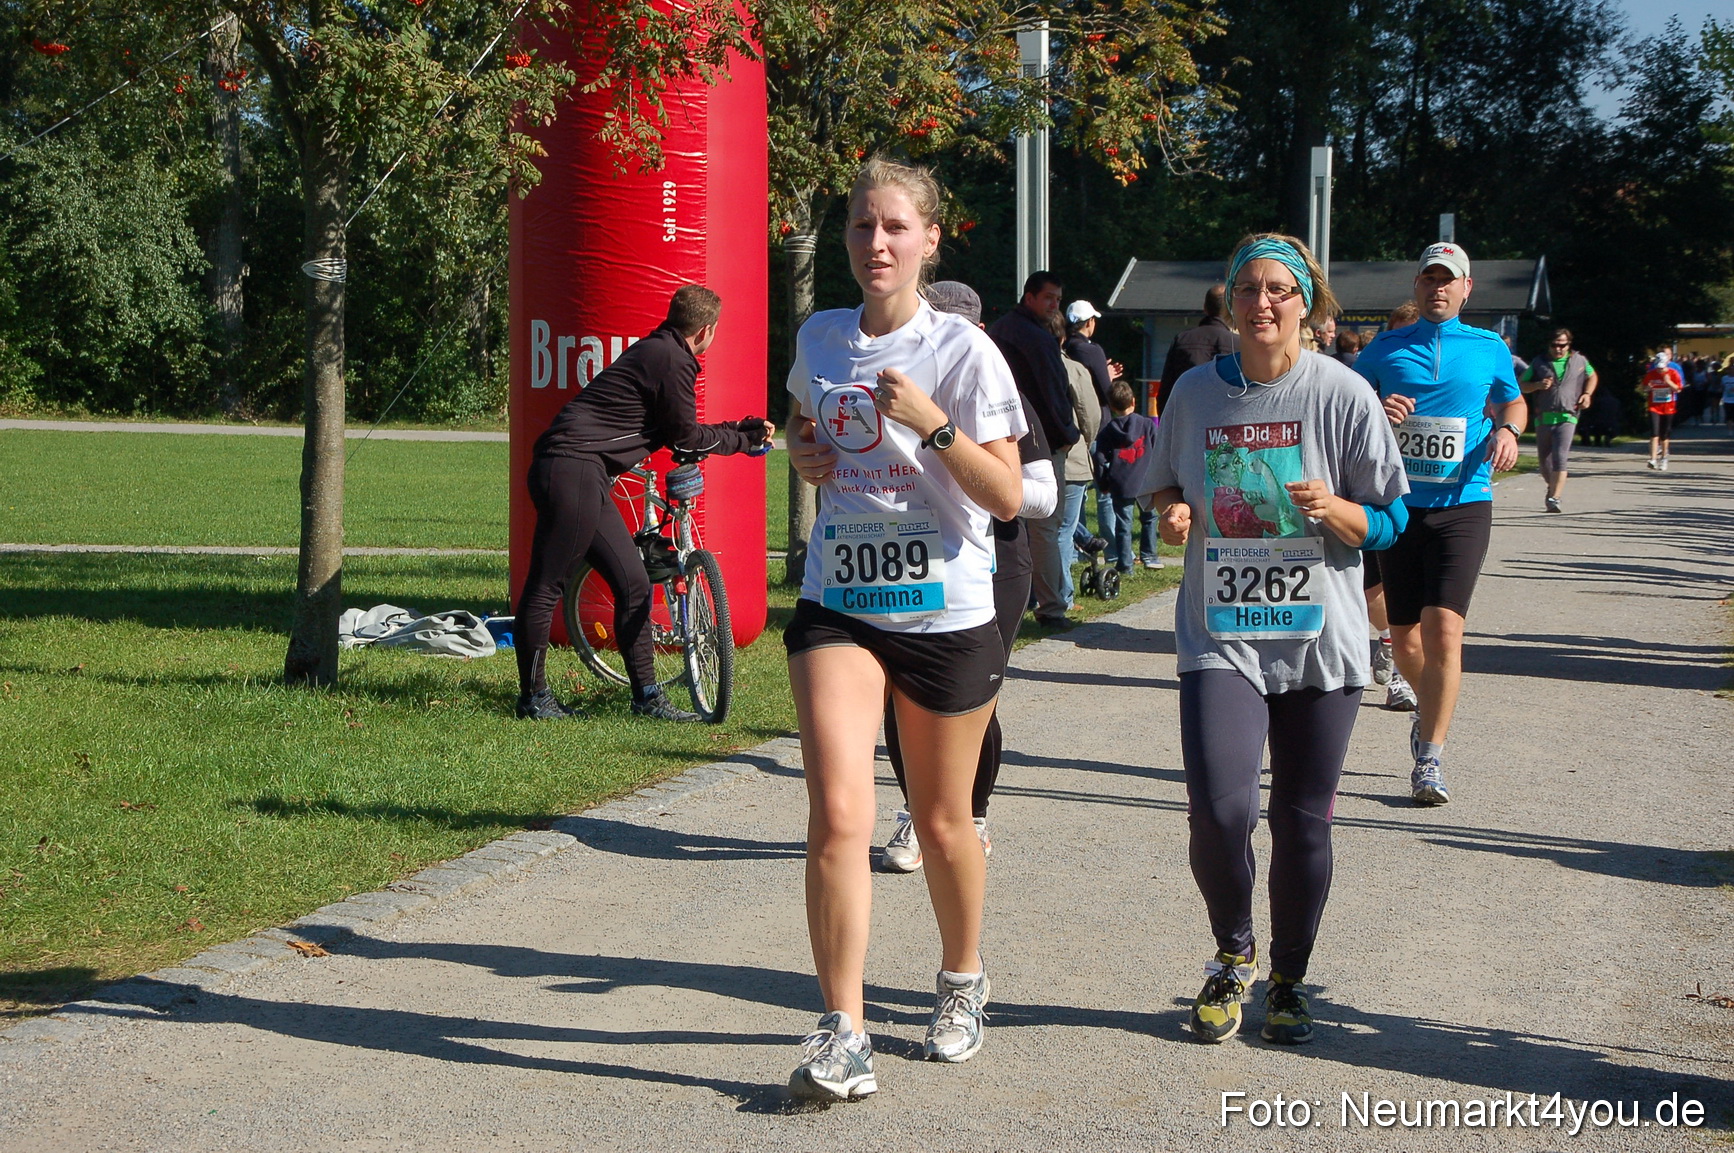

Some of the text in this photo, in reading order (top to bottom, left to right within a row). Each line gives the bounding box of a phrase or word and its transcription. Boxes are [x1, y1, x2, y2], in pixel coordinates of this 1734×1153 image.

[663, 181, 676, 242] Seit 1929
[531, 319, 640, 389] Bra
[1208, 423, 1298, 445] We Did It!
[1400, 431, 1456, 460] 2366
[1405, 458, 1446, 476] Holger
[836, 522, 885, 534] PFLEIDERER
[834, 540, 929, 584] 3089
[1220, 548, 1270, 558] PFLEIDERER
[1216, 565, 1311, 604] 3262
[842, 587, 924, 609] Corinna
[1235, 606, 1293, 627] Heike
